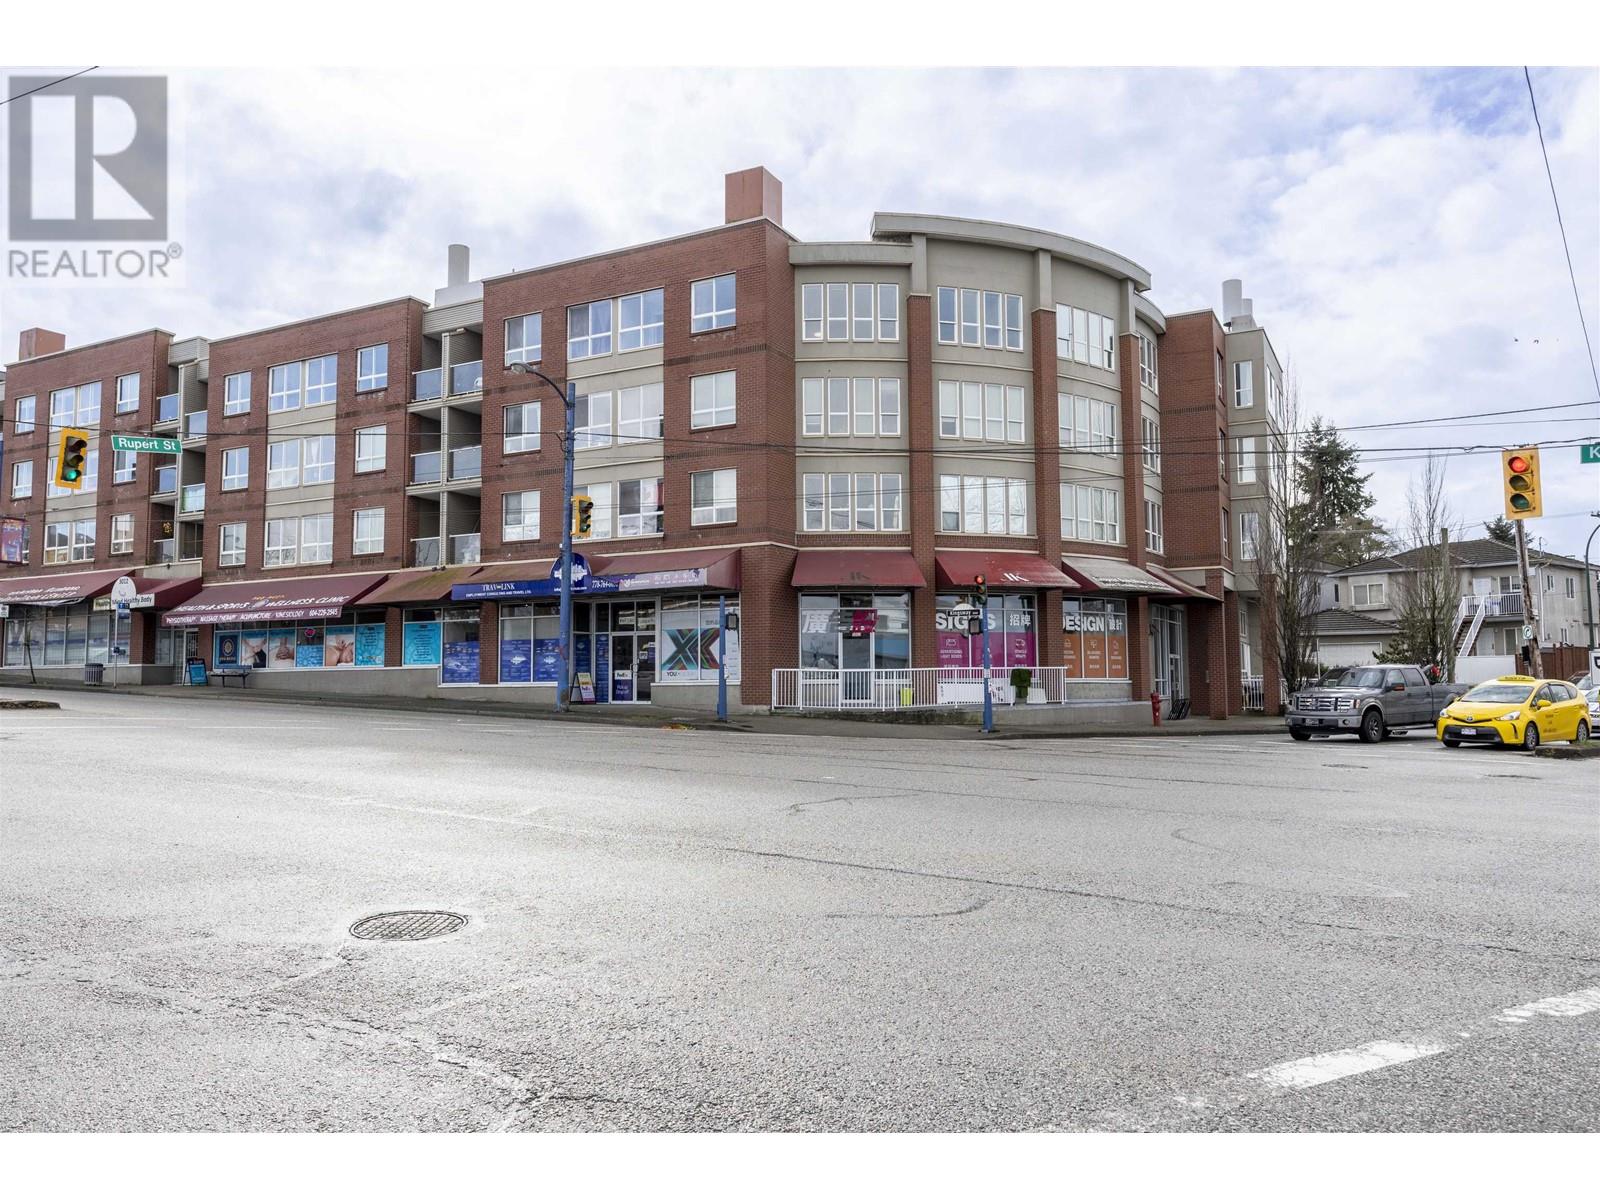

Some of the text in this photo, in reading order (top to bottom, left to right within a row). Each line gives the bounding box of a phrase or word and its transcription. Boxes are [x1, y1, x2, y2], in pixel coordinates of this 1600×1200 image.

[118, 437, 177, 450] Rupert St
[265, 597, 316, 607] WELLNESS
[315, 596, 350, 604] CLINIC
[936, 612, 996, 630] SIGS
[1063, 615, 1105, 632] ESIGN
